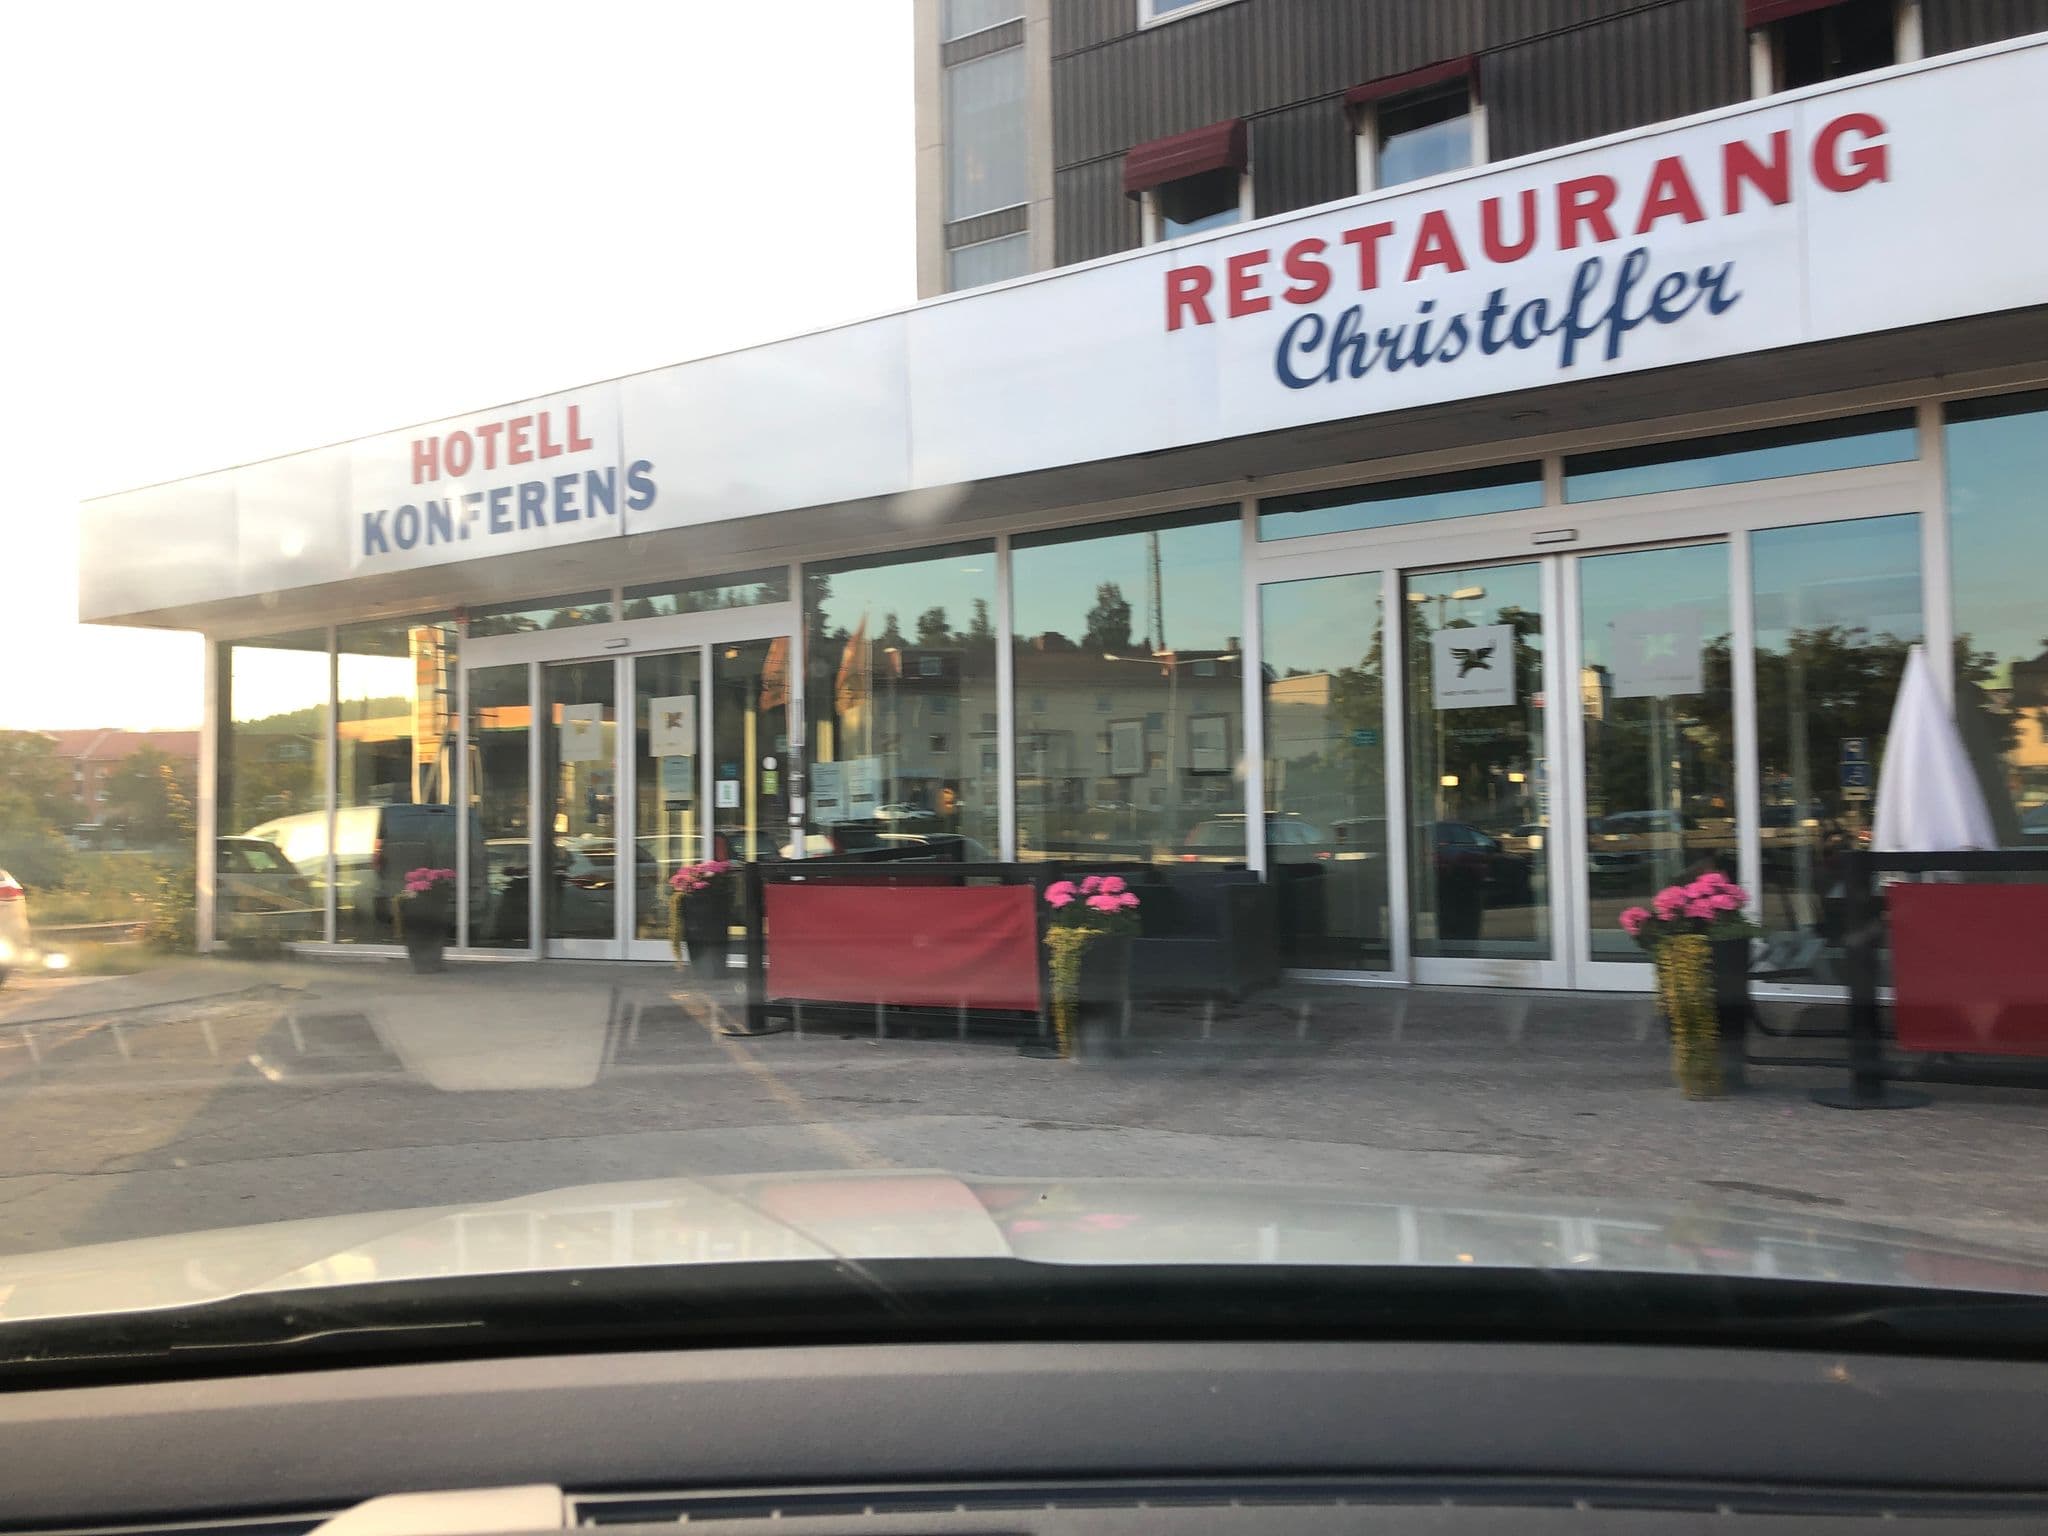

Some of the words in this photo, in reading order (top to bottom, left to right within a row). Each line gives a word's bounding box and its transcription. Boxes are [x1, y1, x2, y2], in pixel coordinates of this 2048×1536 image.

[1165, 113, 1888, 331] RESTAURANG
[1274, 246, 1743, 390] Christoffer
[411, 405, 593, 484] HOTELL
[363, 459, 657, 555] KONFERENS
